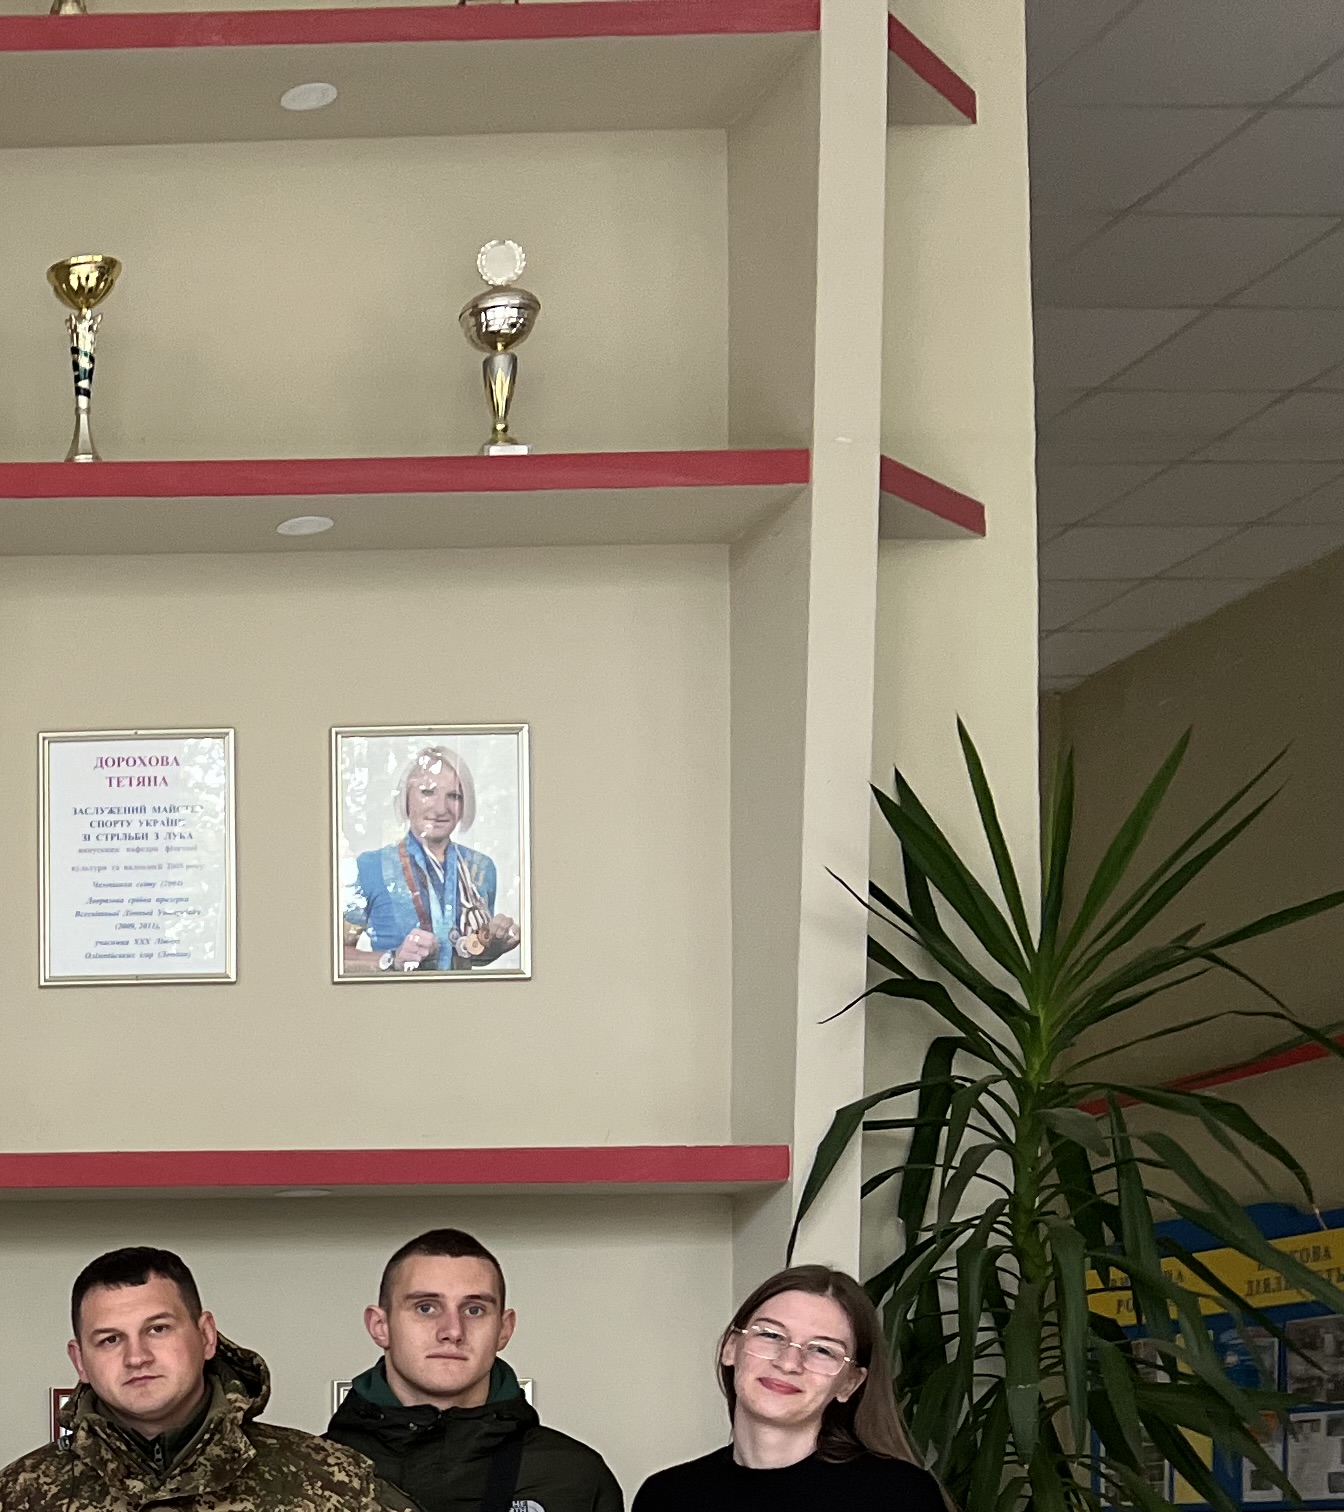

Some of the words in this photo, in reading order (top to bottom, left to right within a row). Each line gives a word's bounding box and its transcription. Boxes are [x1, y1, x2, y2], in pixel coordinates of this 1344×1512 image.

[93, 755, 180, 770] ДОРОХОВА
[105, 776, 168, 788] ТЕТЯНА
[152, 804, 203, 814] МАЙСТЕ
[89, 819, 132, 829] СПОРТУ
